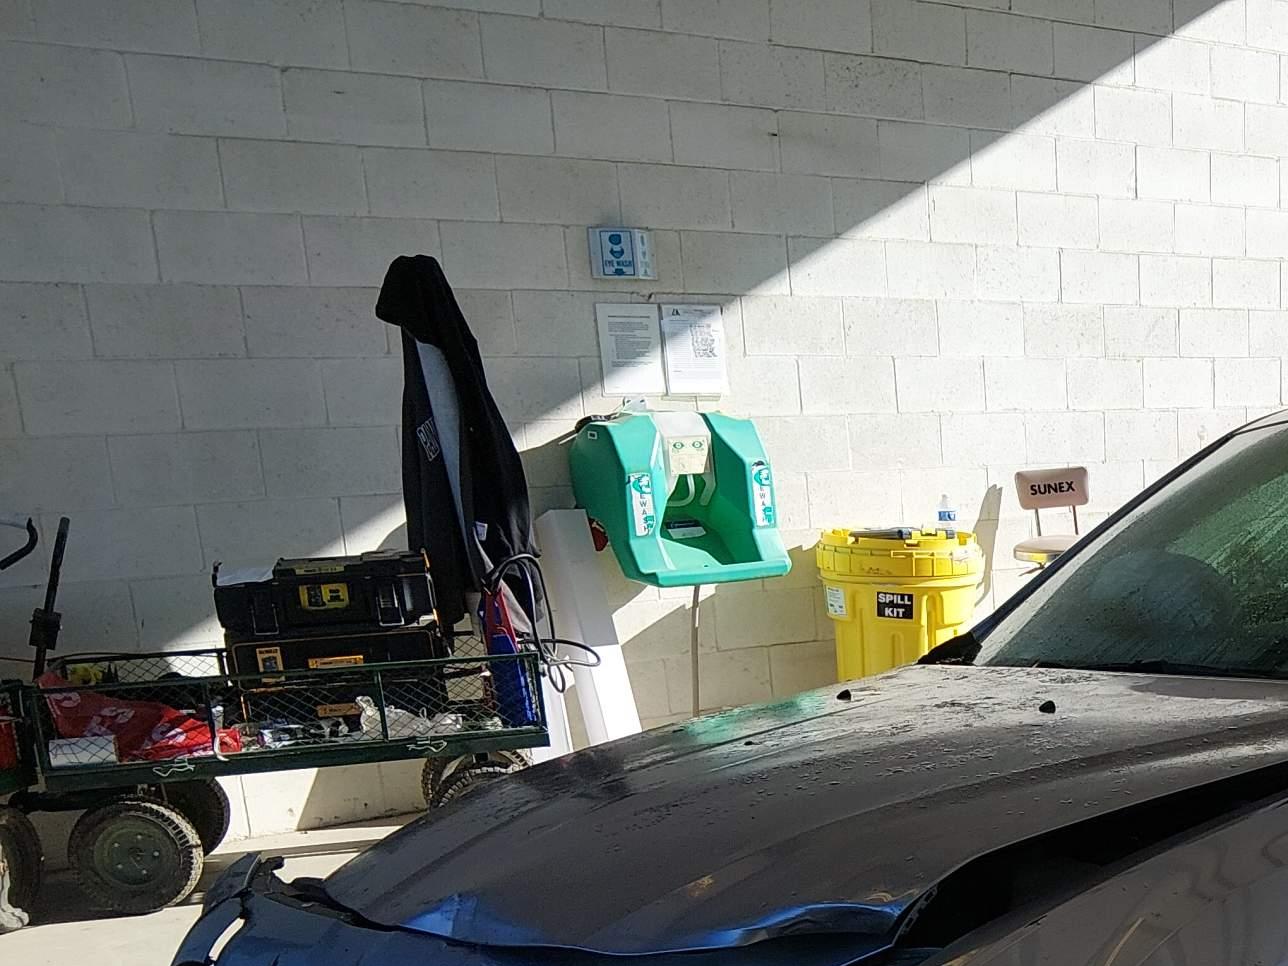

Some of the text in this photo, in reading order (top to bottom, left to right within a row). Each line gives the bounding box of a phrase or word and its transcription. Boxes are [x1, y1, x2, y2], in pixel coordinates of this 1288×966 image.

[616, 260, 633, 268] WASH
[1030, 480, 1076, 496] SUNEX
[878, 593, 912, 605] SPILL
[884, 607, 905, 618] KIT
